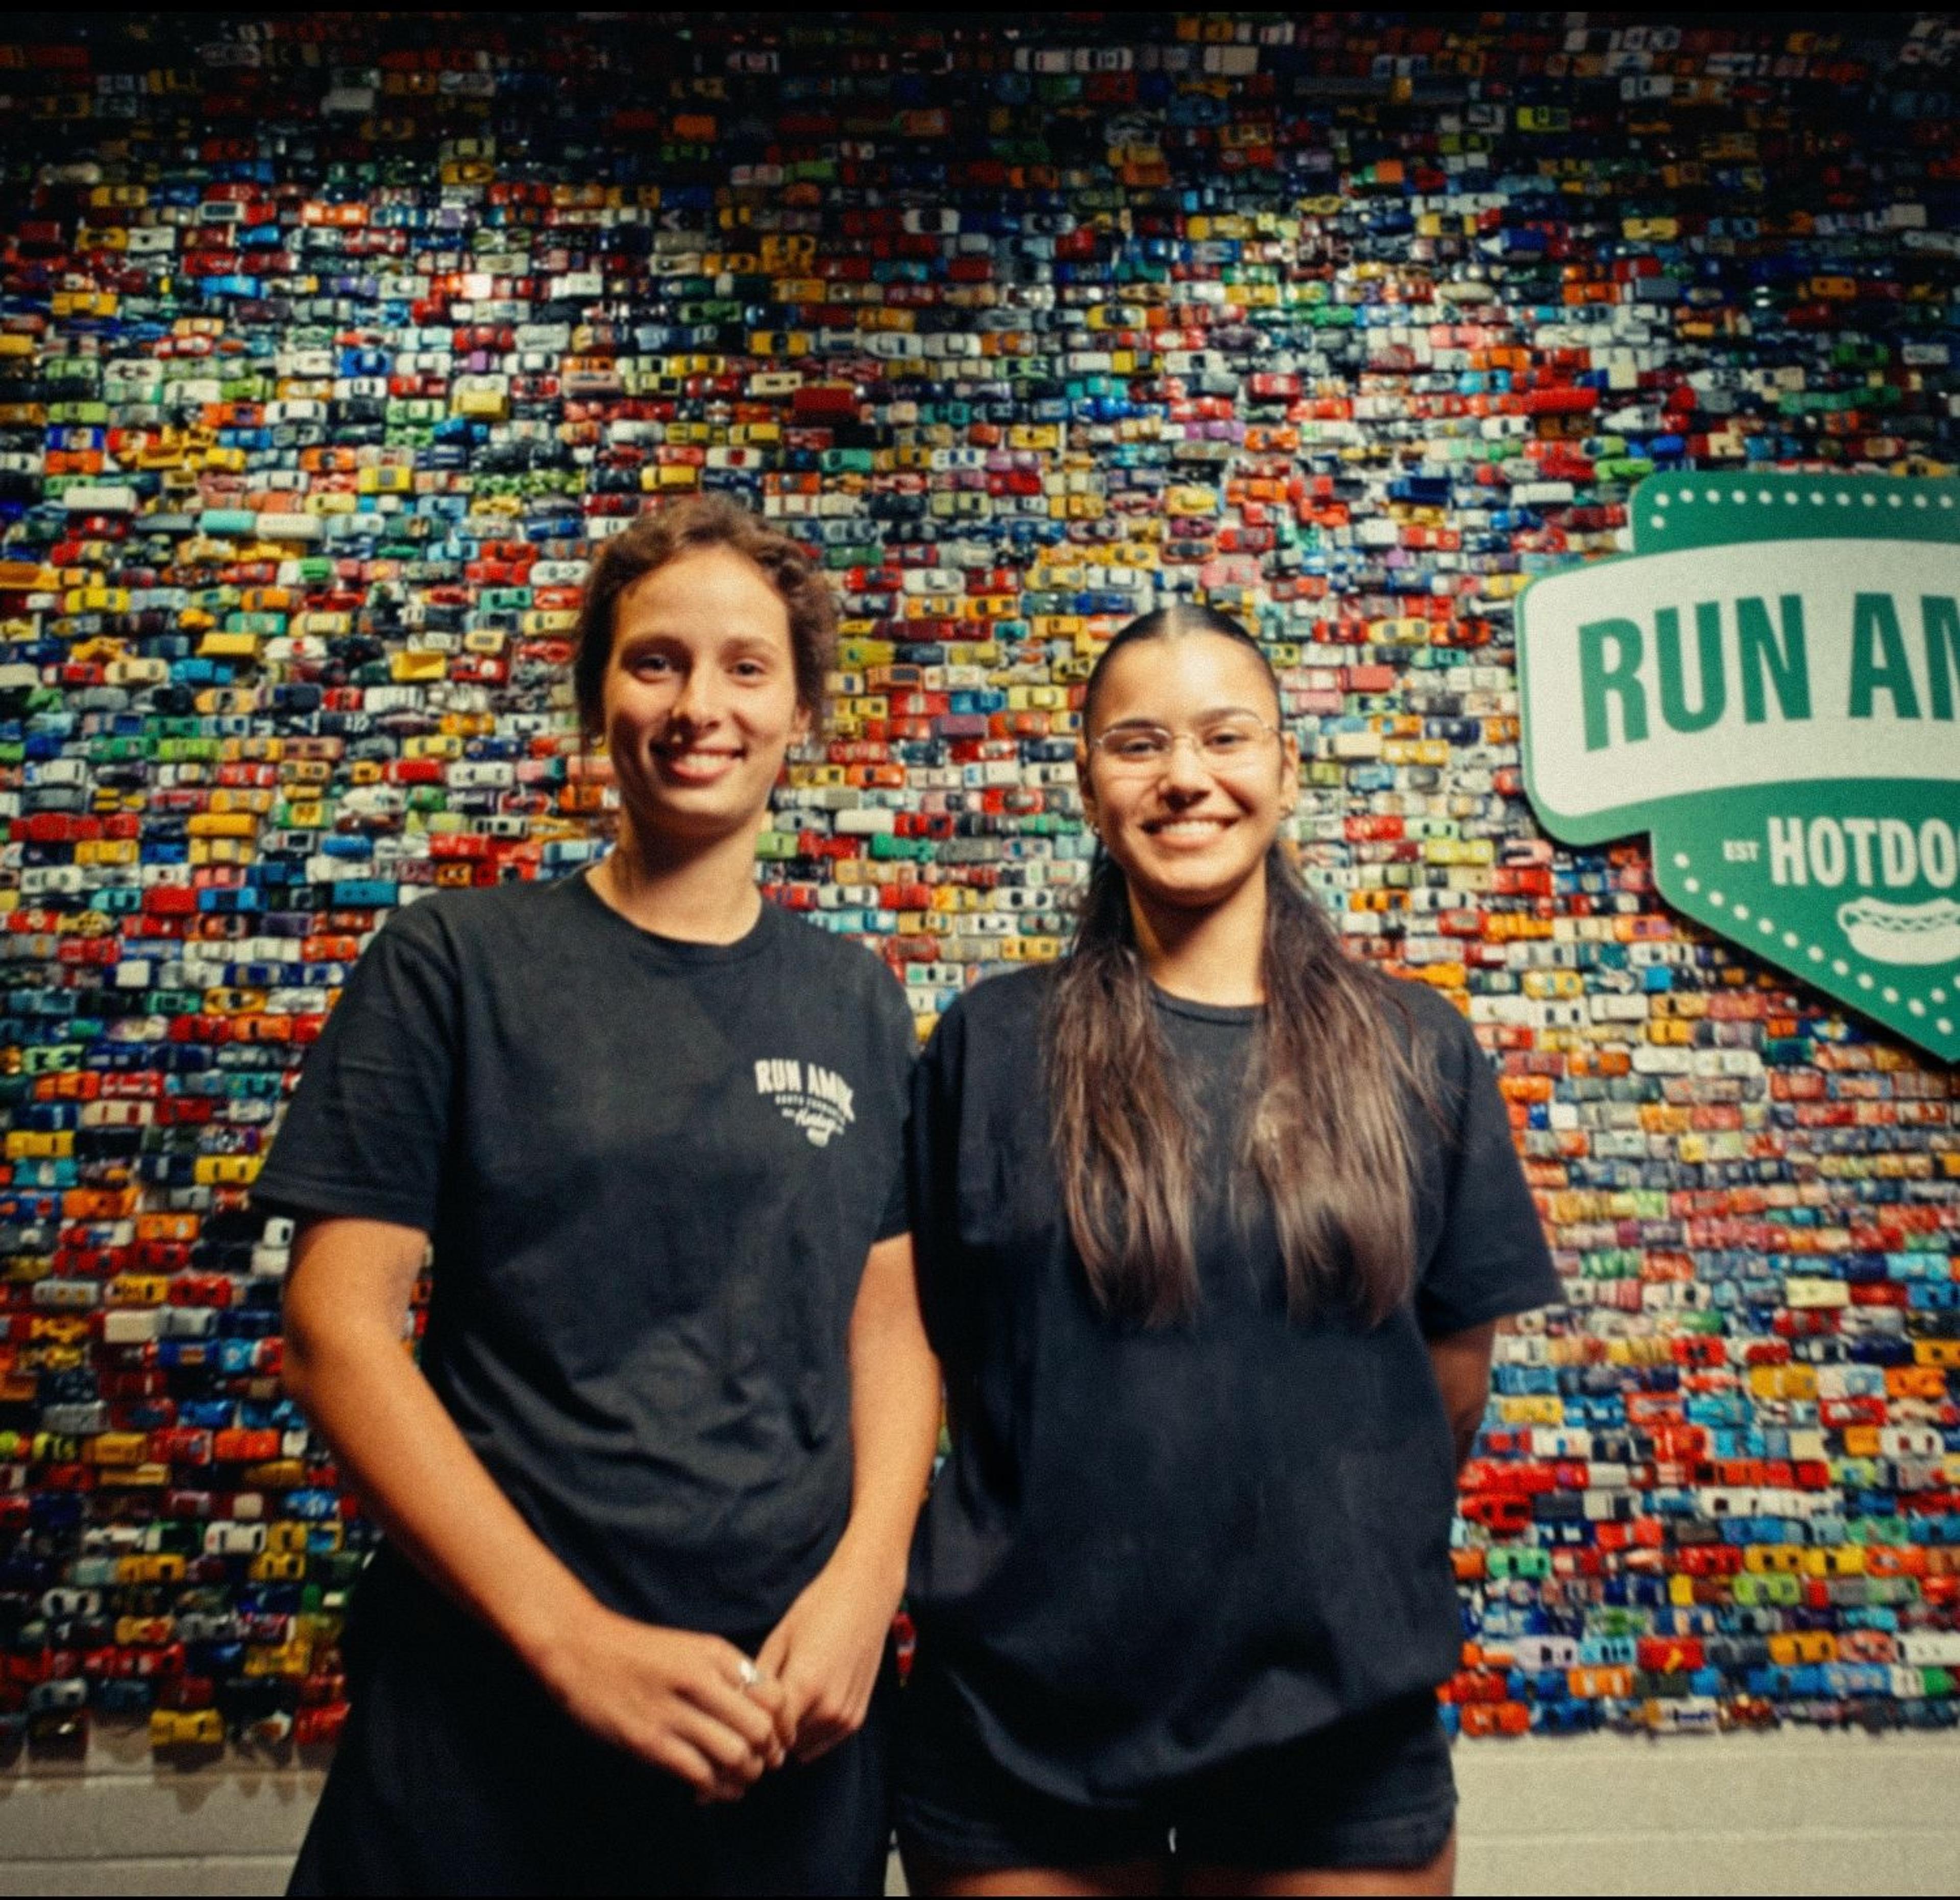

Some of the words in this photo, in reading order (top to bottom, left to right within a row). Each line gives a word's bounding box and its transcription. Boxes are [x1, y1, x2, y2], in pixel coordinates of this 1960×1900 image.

[1578, 593, 1812, 752] RUN
[1767, 816, 1960, 888] HOTDO
[754, 1058, 802, 1094] RUN
